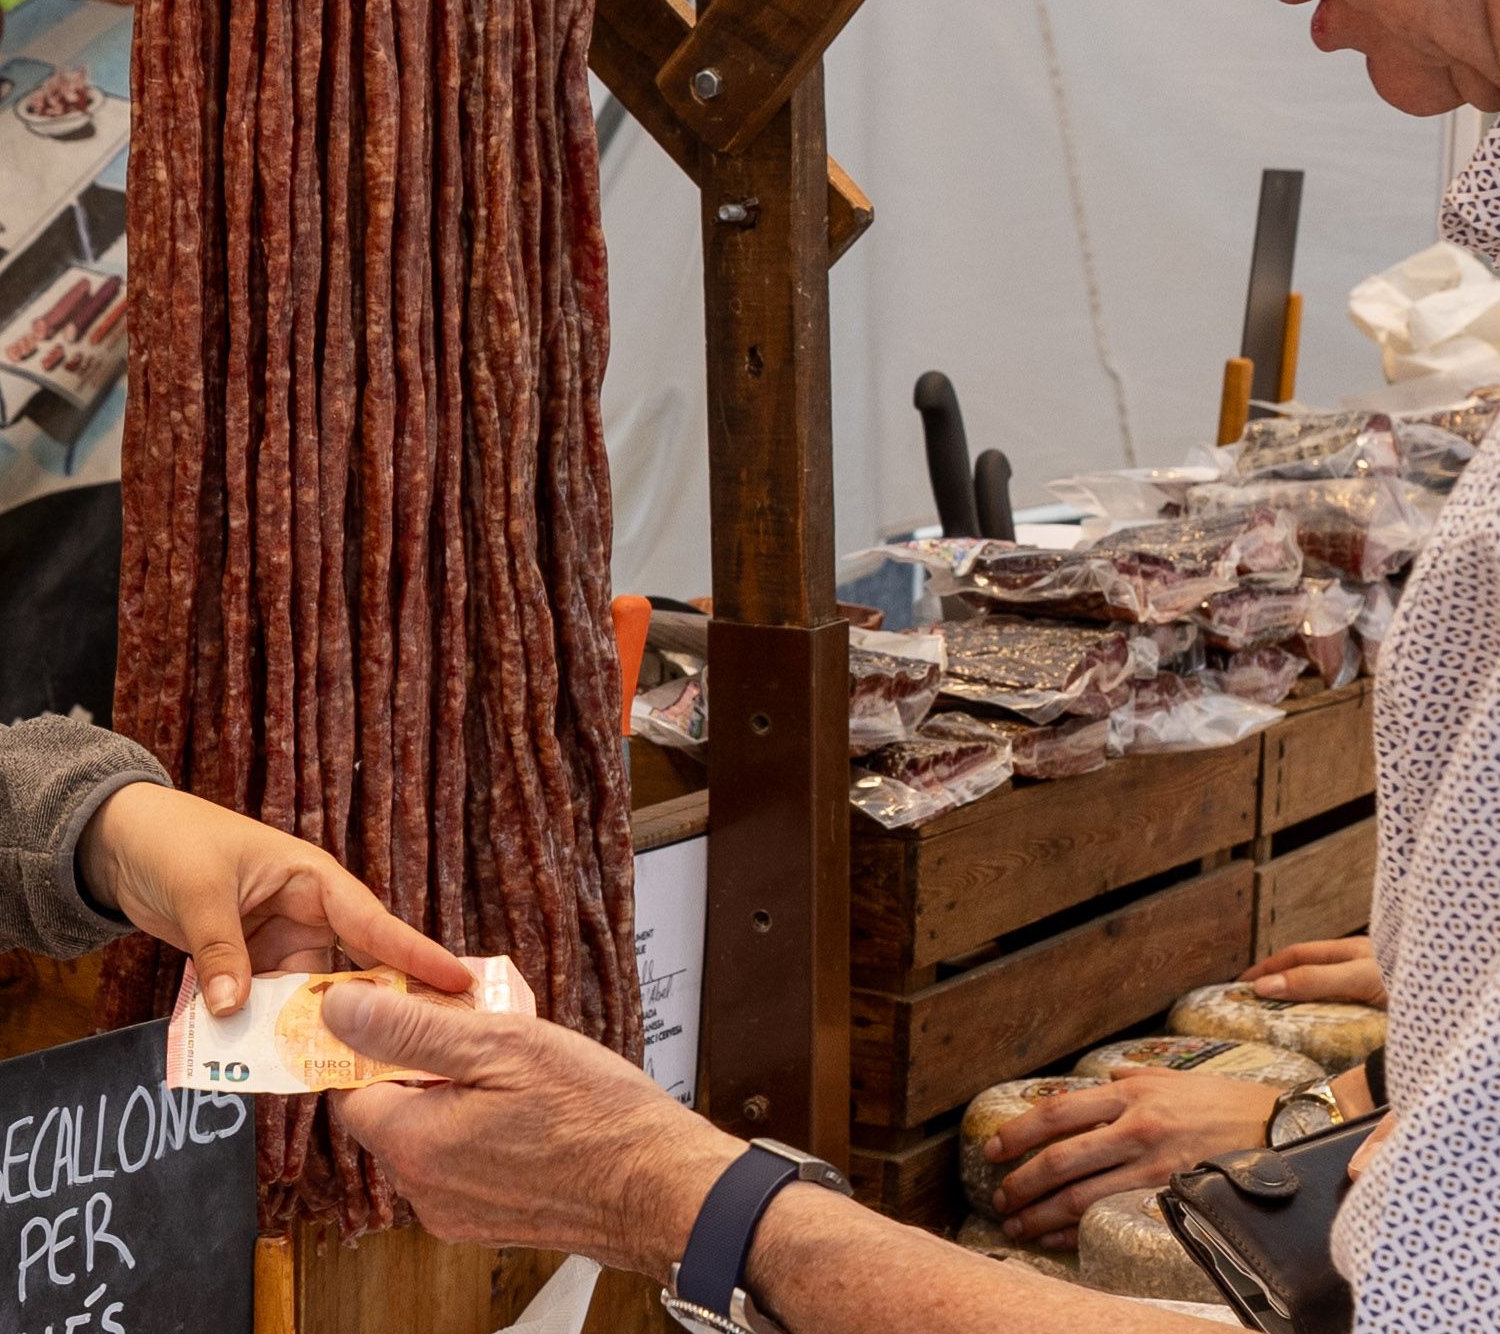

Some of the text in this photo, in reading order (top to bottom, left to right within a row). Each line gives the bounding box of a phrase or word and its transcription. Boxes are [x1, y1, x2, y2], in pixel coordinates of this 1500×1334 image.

[203, 1061, 250, 1083] 10
[303, 1059, 352, 1070] EURO
[18, 1191, 136, 1304] PER
